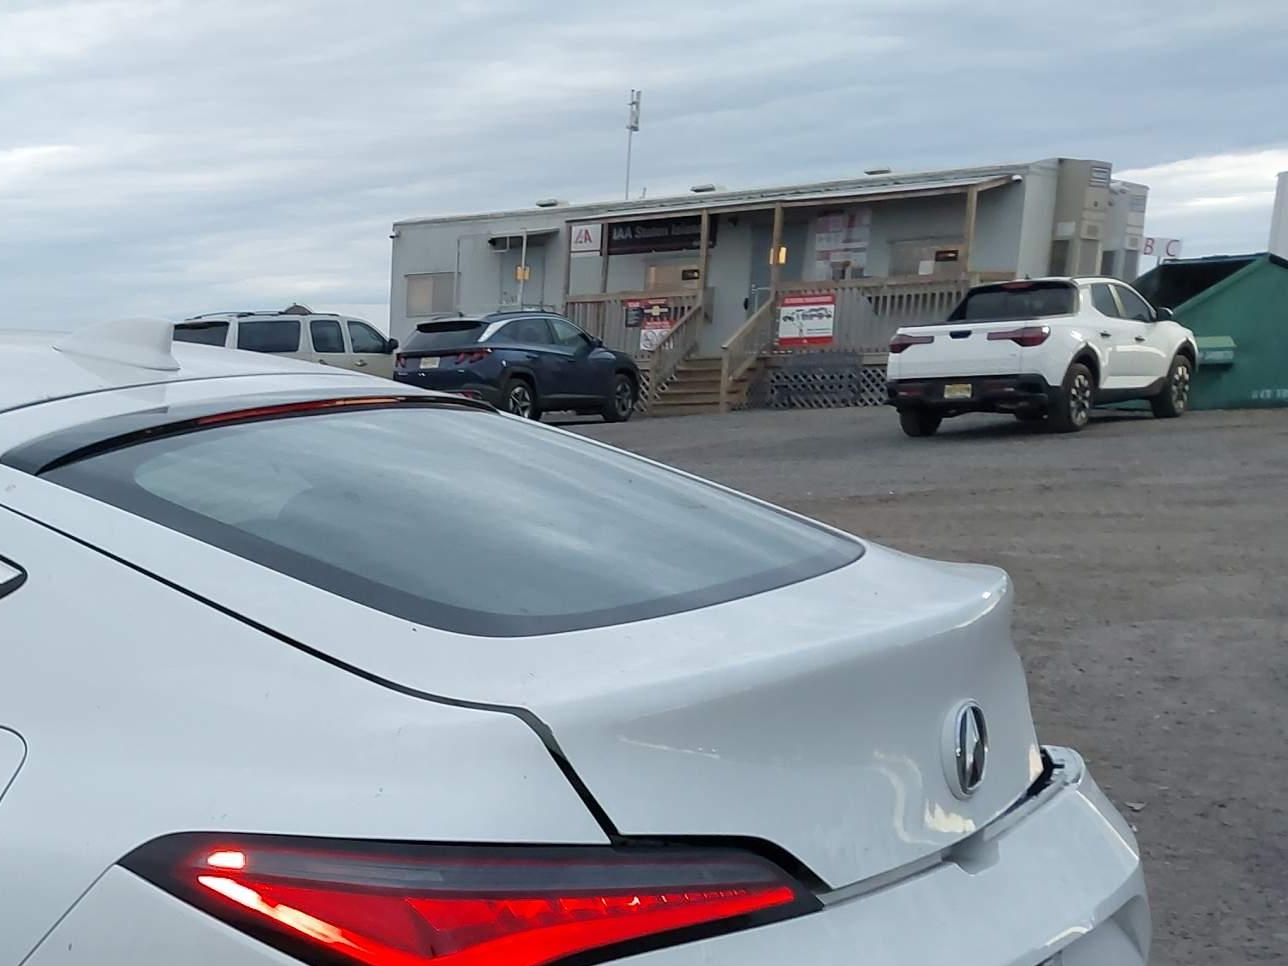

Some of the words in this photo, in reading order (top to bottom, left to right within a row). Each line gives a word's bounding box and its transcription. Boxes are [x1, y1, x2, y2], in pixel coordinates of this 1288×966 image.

[612, 226, 633, 241] IAA
[1143, 237, 1154, 255] B
[1165, 239, 1180, 257] C
